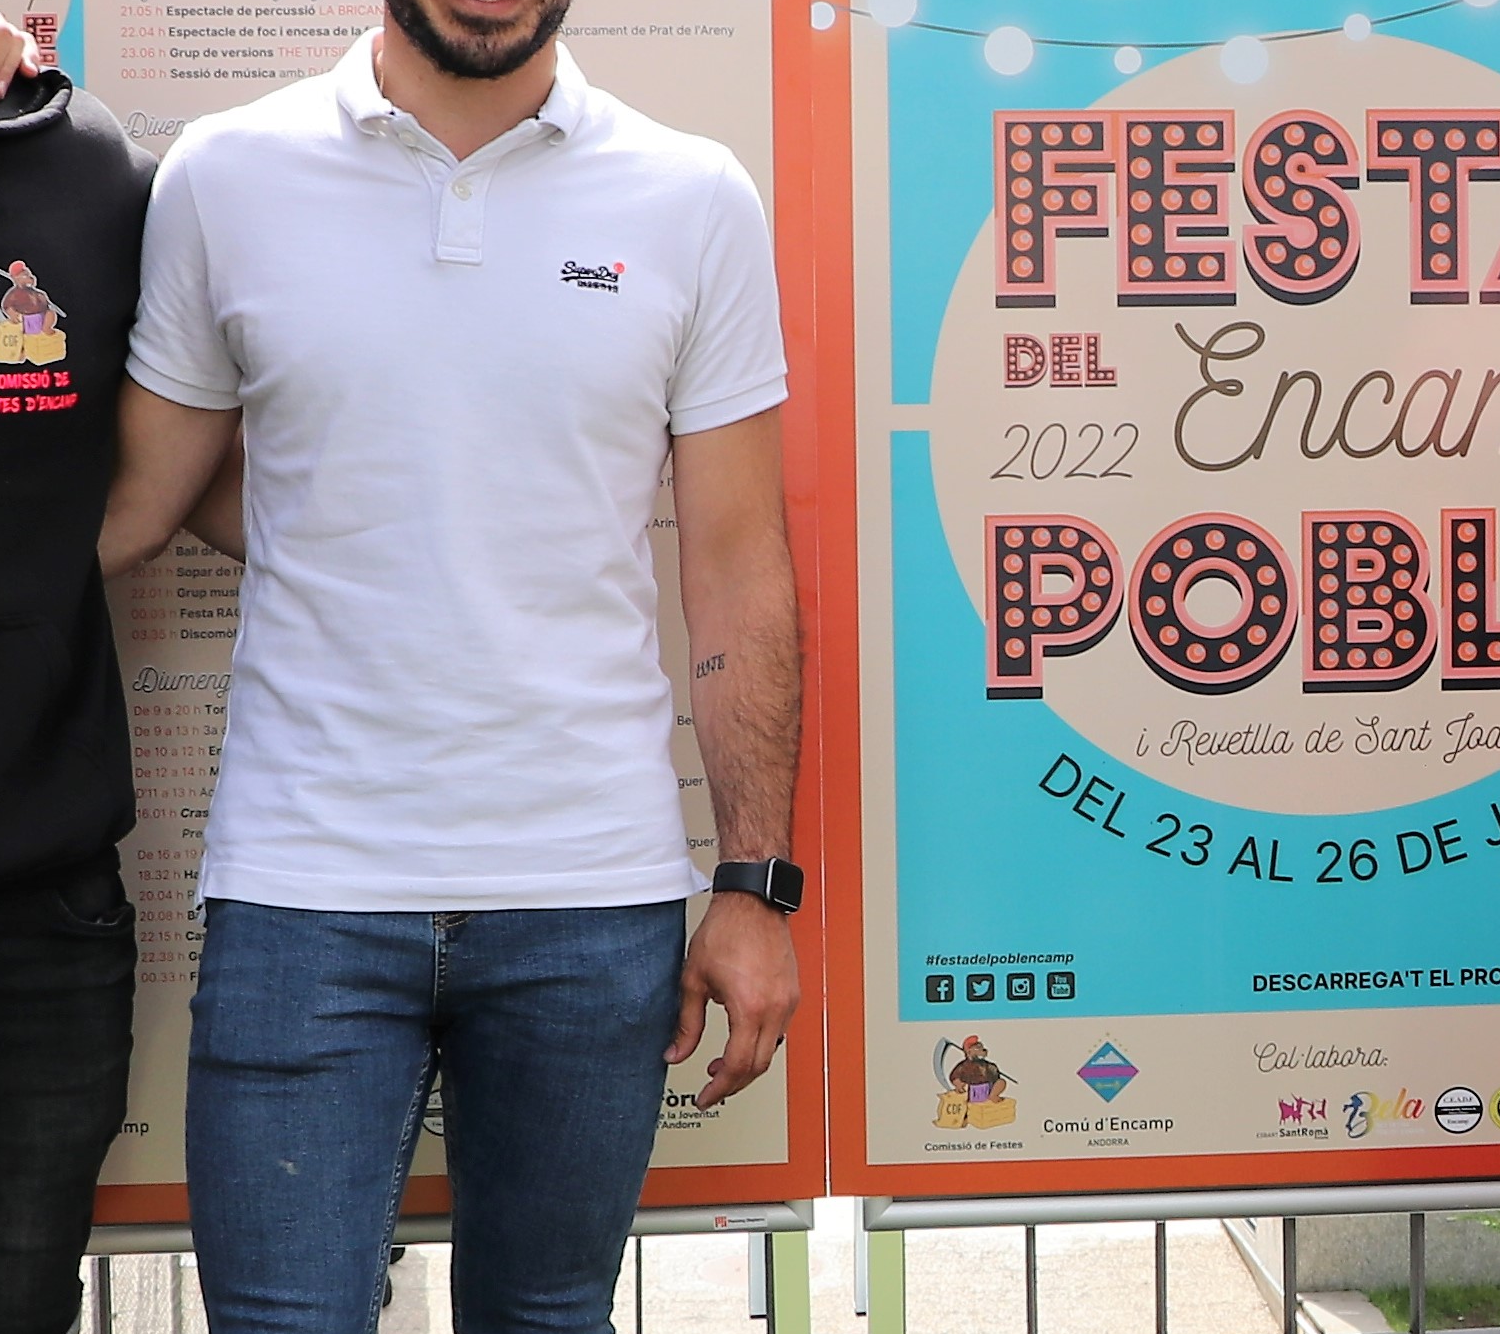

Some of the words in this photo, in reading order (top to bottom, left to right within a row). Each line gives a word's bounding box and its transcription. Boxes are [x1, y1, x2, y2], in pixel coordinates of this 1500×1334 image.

[121, 6, 152, 16] 21.05
[156, 5, 163, 15] h
[166, 5, 233, 18] Espectacle
[237, 5, 252, 16] de
[255, 4, 316, 19] percussió
[319, 5, 335, 16] LA
[338, 5, 384, 16] BRICAN
[121, 27, 154, 37] 22.04
[158, 27, 165, 37] h
[169, 27, 236, 39] Espectacle
[239, 26, 254, 37] de
[257, 26, 277, 37] foc
[287, 28, 330, 37] encesa
[333, 26, 348, 36] de
[351, 26, 361, 36] la
[557, 25, 627, 38] Aparcament
[631, 25, 646, 35] de
[650, 25, 673, 36] Prat
[677, 25, 691, 35] de
[695, 25, 735, 38] l'Areny
[121, 48, 155, 58] 23.06
[159, 47, 166, 57] h
[170, 47, 200, 60] Grup
[203, 47, 218, 58] de
[221, 47, 274, 58] versions
[278, 47, 301, 58] THE
[307, 46, 347, 58] TUTSI
[121, 69, 155, 79] 00.30
[160, 69, 167, 78] h
[170, 68, 211, 79] Sessió
[214, 68, 229, 78] de
[232, 67, 276, 79] música
[279, 68, 305, 78] amb
[1003, 333, 1118, 388] DEL
[53, 371, 70, 387] DE
[991, 422, 1140, 481] 2022
[176, 546, 198, 557] Ball
[177, 567, 213, 579] Sopar
[216, 567, 231, 577] de
[177, 588, 207, 600] Grup
[180, 608, 214, 618] Festa
[133, 667, 232, 698] Diumeng
[134, 706, 150, 716] De
[135, 727, 150, 737] De
[1137, 727, 1150, 758] i
[1160, 719, 1294, 767] Revetlla
[1305, 722, 1344, 755] de
[1354, 716, 1432, 757] Sant
[135, 748, 151, 757] De
[155, 747, 167, 757] 10
[135, 768, 151, 778] De
[156, 767, 167, 777] 12
[182, 767, 195, 777] 14
[1038, 752, 1127, 839] DEL
[1145, 812, 1215, 867] 23
[1228, 835, 1295, 883] AL
[1315, 838, 1379, 884] 26
[1396, 819, 1469, 875] DE
[138, 850, 153, 859] De
[140, 891, 172, 900] 20.04
[925, 951, 1074, 967] #festadelpoblencamp
[1252, 970, 1424, 994] DESCARREGA'T
[1430, 969, 1455, 988] EL
[667, 1111, 676, 1119] la
[679, 1110, 720, 1119] Joventut
[1043, 1117, 1090, 1133] Comú
[1094, 1116, 1174, 1133] d'Encamp
[924, 1142, 972, 1152] Comissió
[974, 1142, 987, 1151] de
[990, 1141, 1023, 1150] Festes
[1087, 1138, 1130, 1147] ANDORRA
